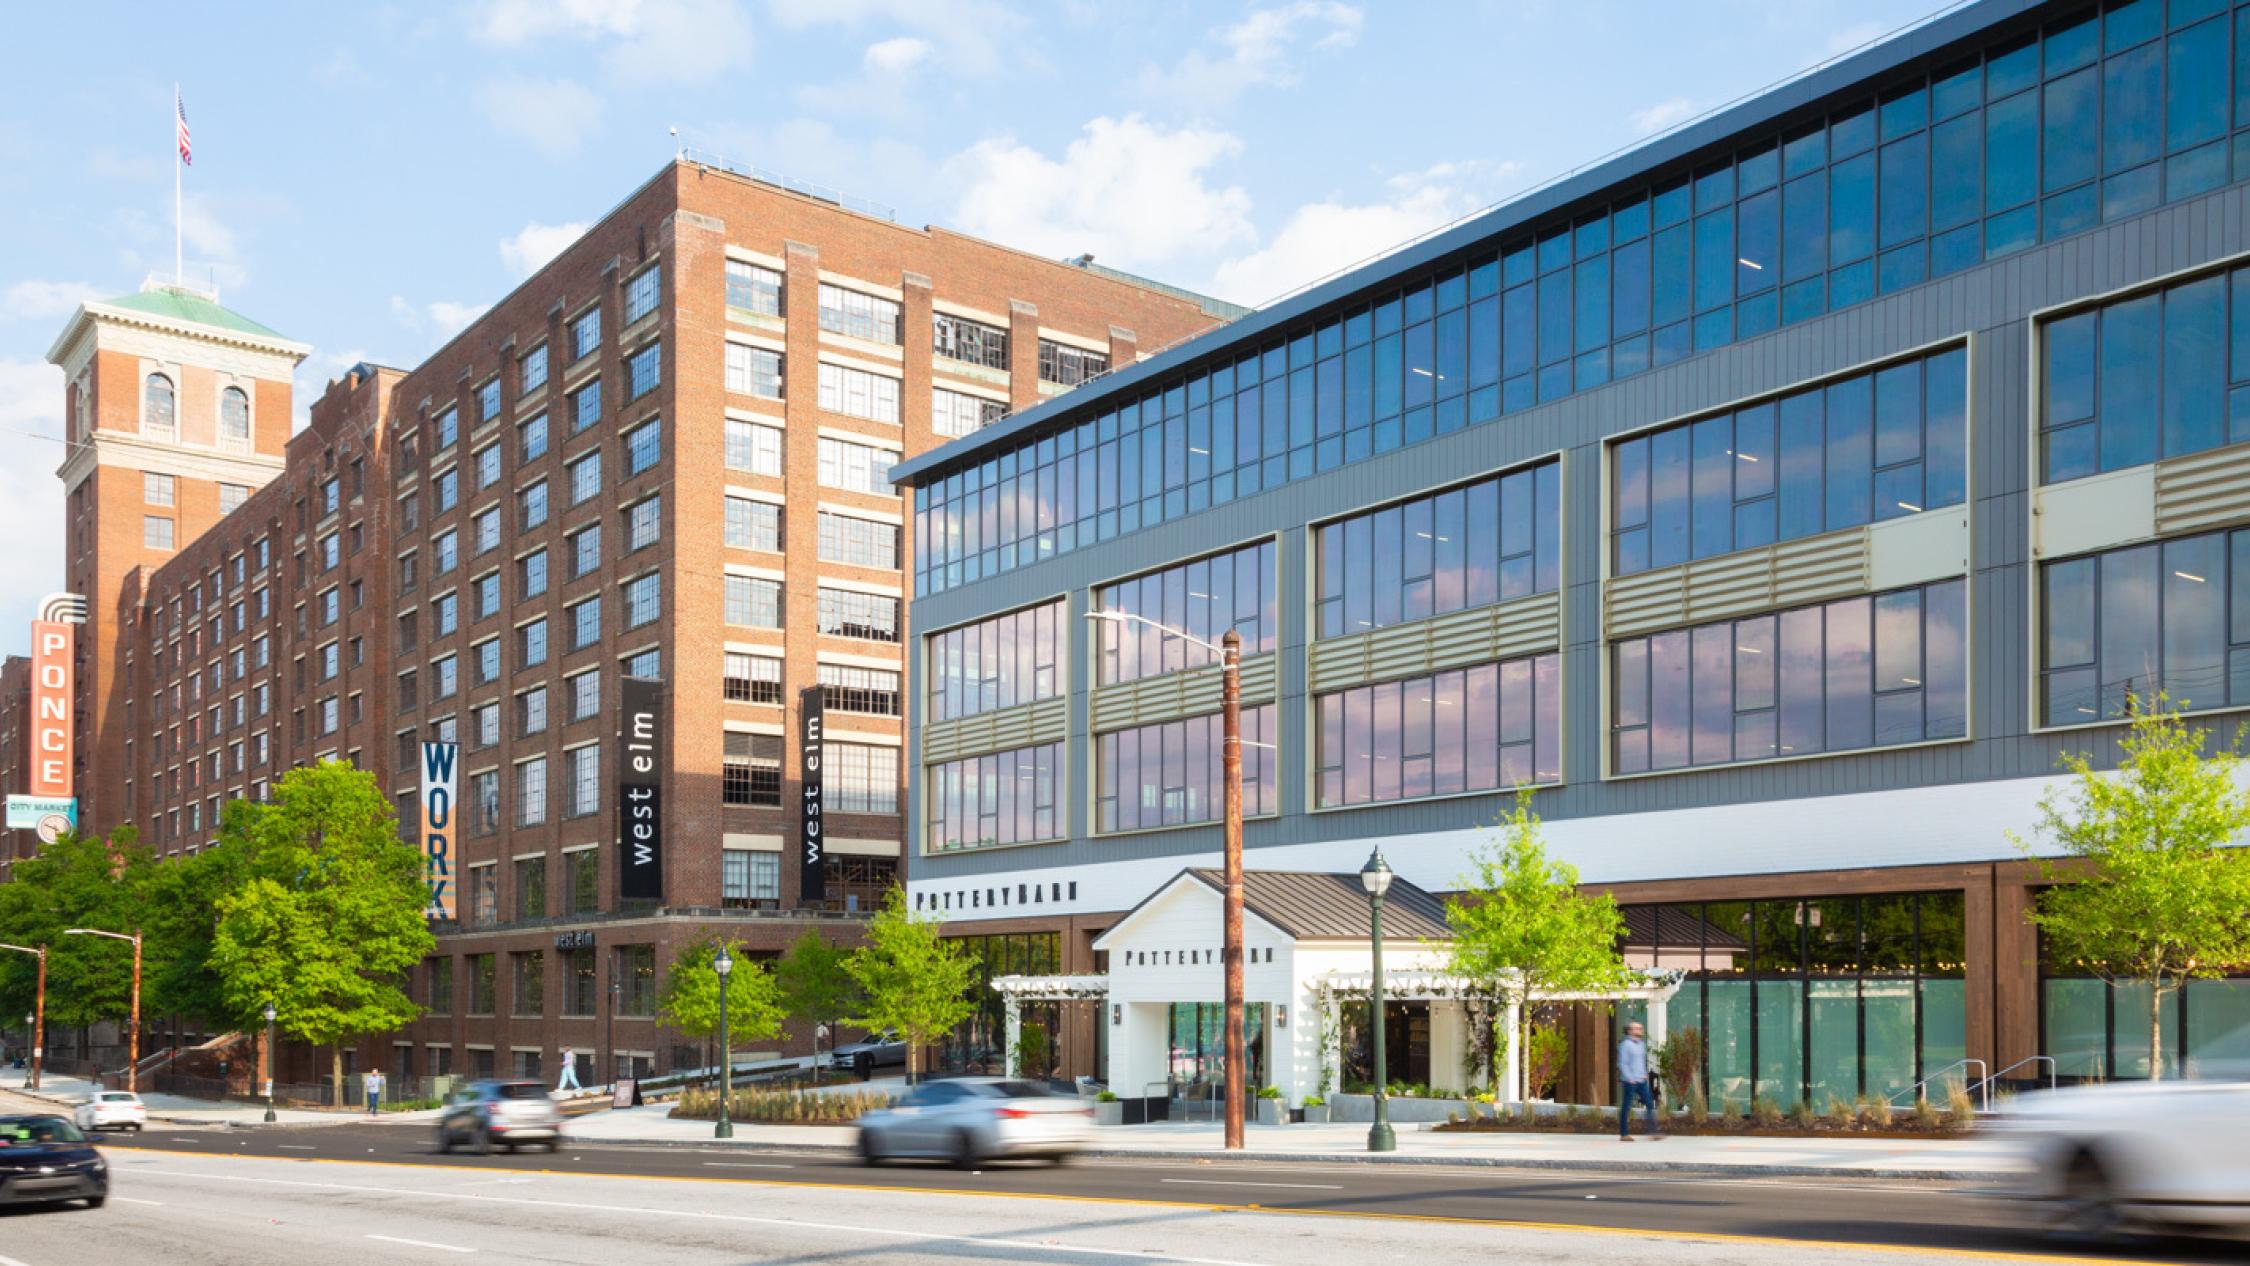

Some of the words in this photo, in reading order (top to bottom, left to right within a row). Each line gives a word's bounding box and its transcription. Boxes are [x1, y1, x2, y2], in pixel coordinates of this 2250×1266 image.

[41, 633, 66, 783] PONCE
[628, 712, 653, 773] elm
[805, 717, 819, 770] elm
[425, 743, 455, 919] WORK
[628, 787, 653, 866] west
[805, 785, 819, 864] west
